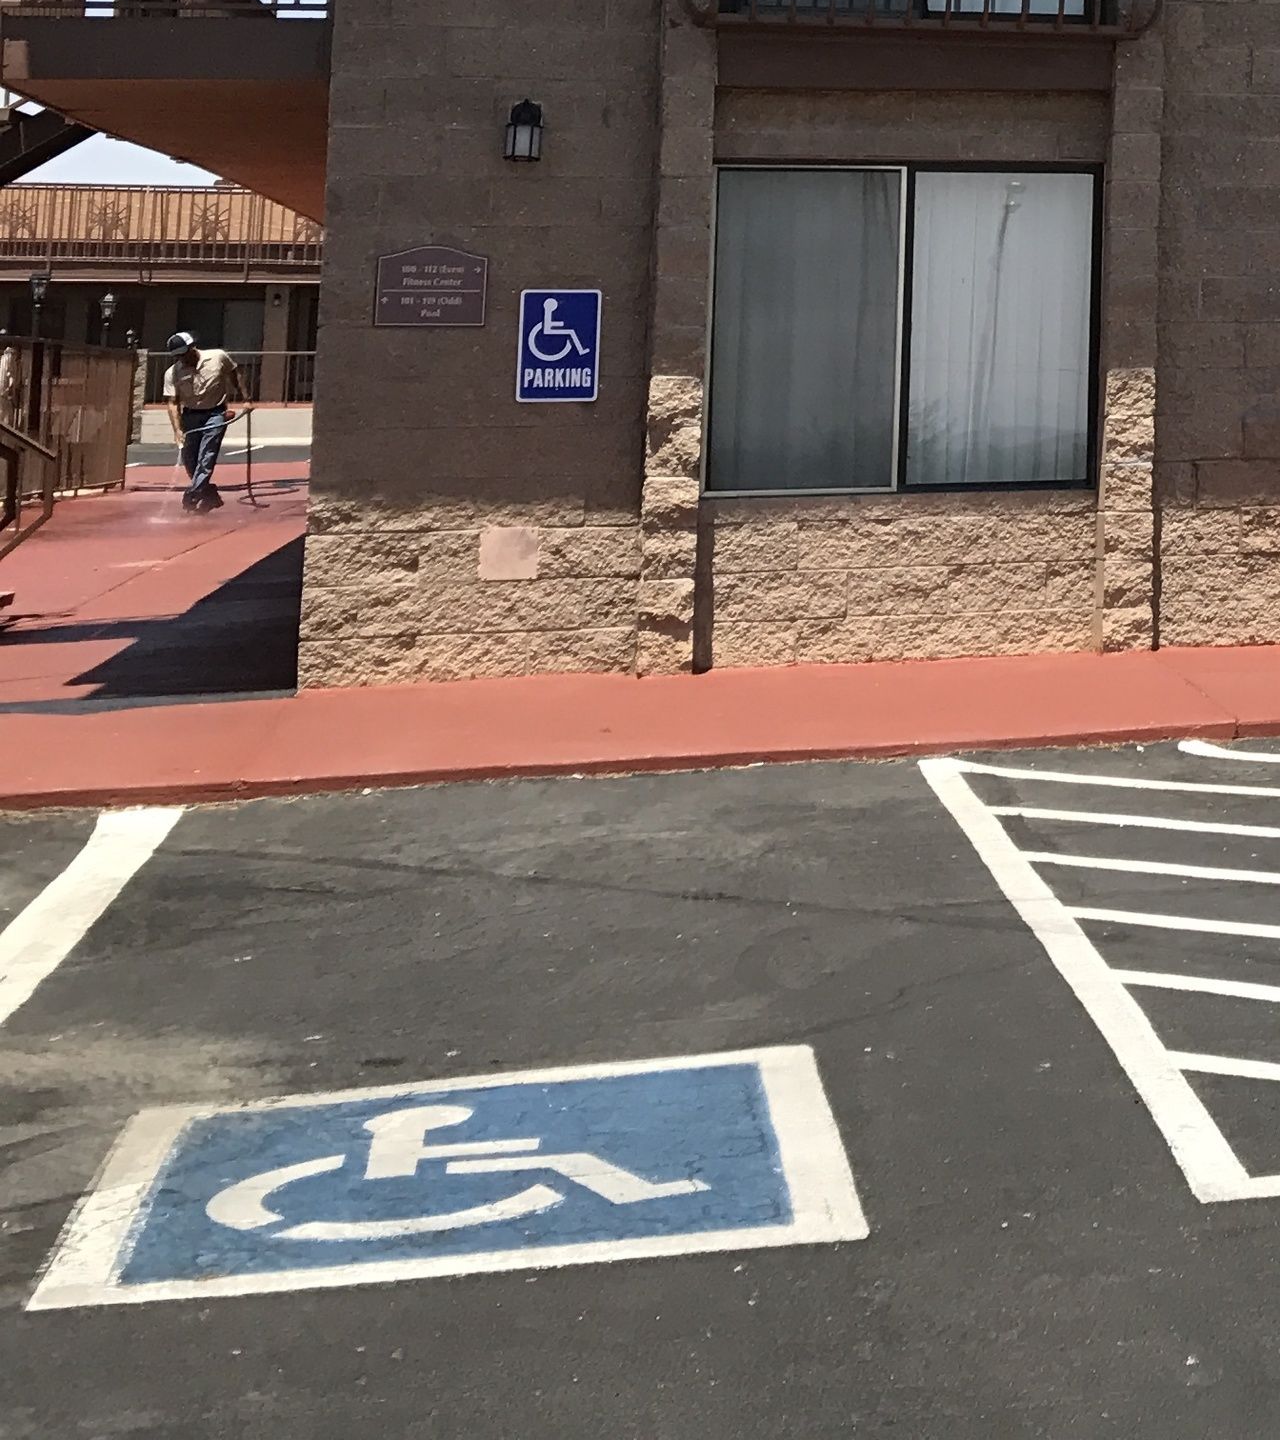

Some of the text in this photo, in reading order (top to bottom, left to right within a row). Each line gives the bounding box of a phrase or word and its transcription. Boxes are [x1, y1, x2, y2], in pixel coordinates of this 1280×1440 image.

[402, 277, 464, 286] Fitness Center
[420, 308, 441, 318] Pool
[523, 367, 592, 388] PARKING
